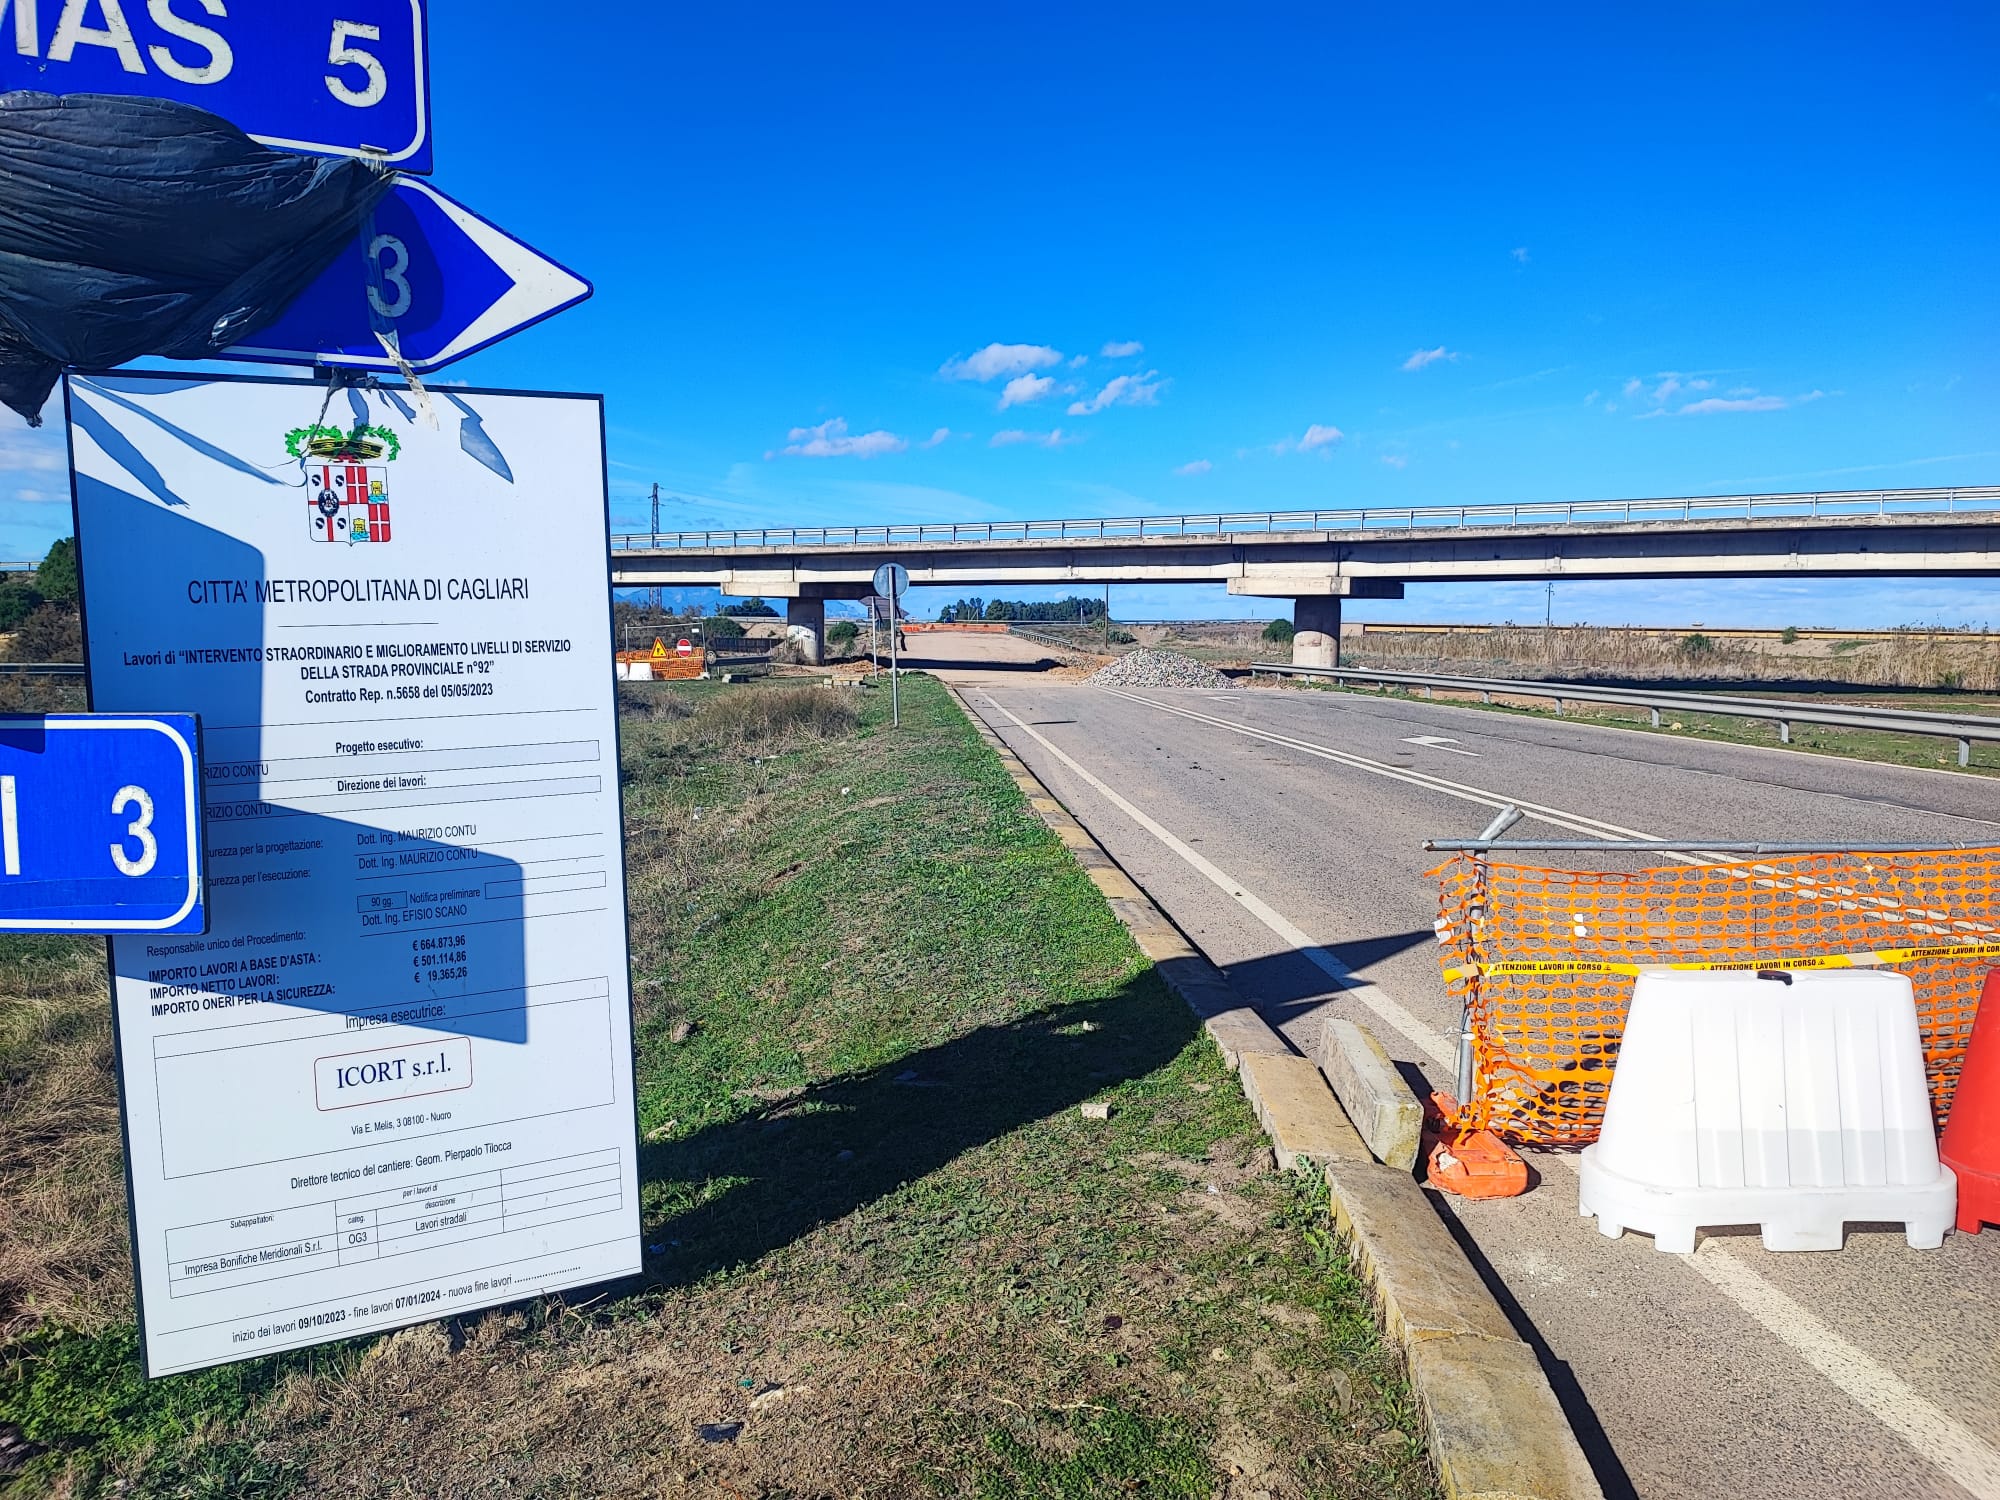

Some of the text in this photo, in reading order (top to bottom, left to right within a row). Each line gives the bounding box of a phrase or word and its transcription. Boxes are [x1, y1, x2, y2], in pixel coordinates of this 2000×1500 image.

[325, 19, 387, 107] 5
[367, 234, 412, 318] 3
[187, 577, 529, 604] CITTA' METROPOLITANA DI CAGLIARI
[123, 651, 162, 666] Lavori
[165, 650, 176, 665] di
[266, 645, 363, 661] STRAORDINARIO
[366, 645, 373, 658] E
[376, 642, 468, 658] MIGLIORAMENTO
[471, 641, 509, 655] LIVELLI
[512, 640, 522, 653] DI
[525, 639, 571, 653] SERVIZIO
[301, 665, 339, 680] DELLA
[342, 664, 389, 679] STRADA
[391, 661, 464, 677] PROVINCIALE
[305, 682, 493, 704] Contratto Rep. n.5658 del 05/05/2023
[335, 738, 424, 756] Progetto esecutivo:
[204, 764, 269, 779] RIZIO CONTU
[337, 775, 427, 792] Direzione dei lavori:
[206, 803, 272, 818] RIZIO CONTU
[110, 784, 158, 877] 3
[357, 824, 477, 846] Dott. Ing. MAURIZIO CONTU
[208, 839, 324, 858] urezza per la progettazione:
[358, 848, 478, 870] Dott. Ing. MAURIZIO CONTU
[242, 874, 256, 886] per
[258, 868, 311, 882] l'esecuzione:
[371, 888, 481, 909] 90 gg. Notifica preliminare
[362, 904, 468, 927] Dott. Ing. EFISIO SCANO
[146, 930, 306, 958] Responsabile unico del Procedimento:
[412, 934, 466, 951] € 664.873,96
[1910, 948, 1950, 957] ATTENZIONE
[1952, 947, 1976, 955] LAVORI
[1986, 945, 2000, 953] COR
[149, 966, 197, 983] IMPORTO
[200, 961, 238, 977] LAVORI
[240, 960, 248, 972] A
[250, 956, 277, 971] BASE
[280, 952, 315, 967] D'ASTA
[413, 950, 467, 967] € 501.114,86
[1576, 963, 1602, 971] CORSO
[1755, 961, 1781, 969] LAVORI
[1793, 959, 1816, 967] CORSO
[414, 966, 468, 983] € 19.365,26
[150, 974, 280, 1000] IMPORTO NETTO LAVORI:
[151, 984, 336, 1017] IMPORTO ONERI PER LA SICUREZZA:
[345, 1004, 446, 1031] Impresa esecutrice:
[336, 1052, 452, 1089] ICORT s.r.l.
[351, 1124, 363, 1135] Via
[365, 1123, 373, 1133] E.
[374, 1119, 395, 1132] Melis,
[396, 1118, 401, 1128] 3
[402, 1114, 424, 1126] 08100
[430, 1111, 452, 1122] Nuoro
[290, 1140, 512, 1190] Direttore tecnico del cantiere: Geom. Pierpaolo Tilocca
[402, 1189, 413, 1199] per
[416, 1185, 431, 1194] lavori
[415, 1211, 467, 1231] Lavori stradali
[348, 1232, 368, 1245] OG3
[184, 1240, 323, 1276] Impresa Bonifiche Meridionali S.r.l.
[232, 1330, 255, 1343] inizio
[257, 1325, 271, 1338] dei
[272, 1322, 296, 1335] lavori
[298, 1310, 346, 1329] 09/10/2023
[353, 1306, 369, 1318] fine
[371, 1299, 394, 1314] lavori
[395, 1289, 440, 1309] 07/01/2024
[448, 1286, 473, 1298] nuova
[474, 1280, 489, 1292] fine
[490, 1273, 512, 1287] lavori
